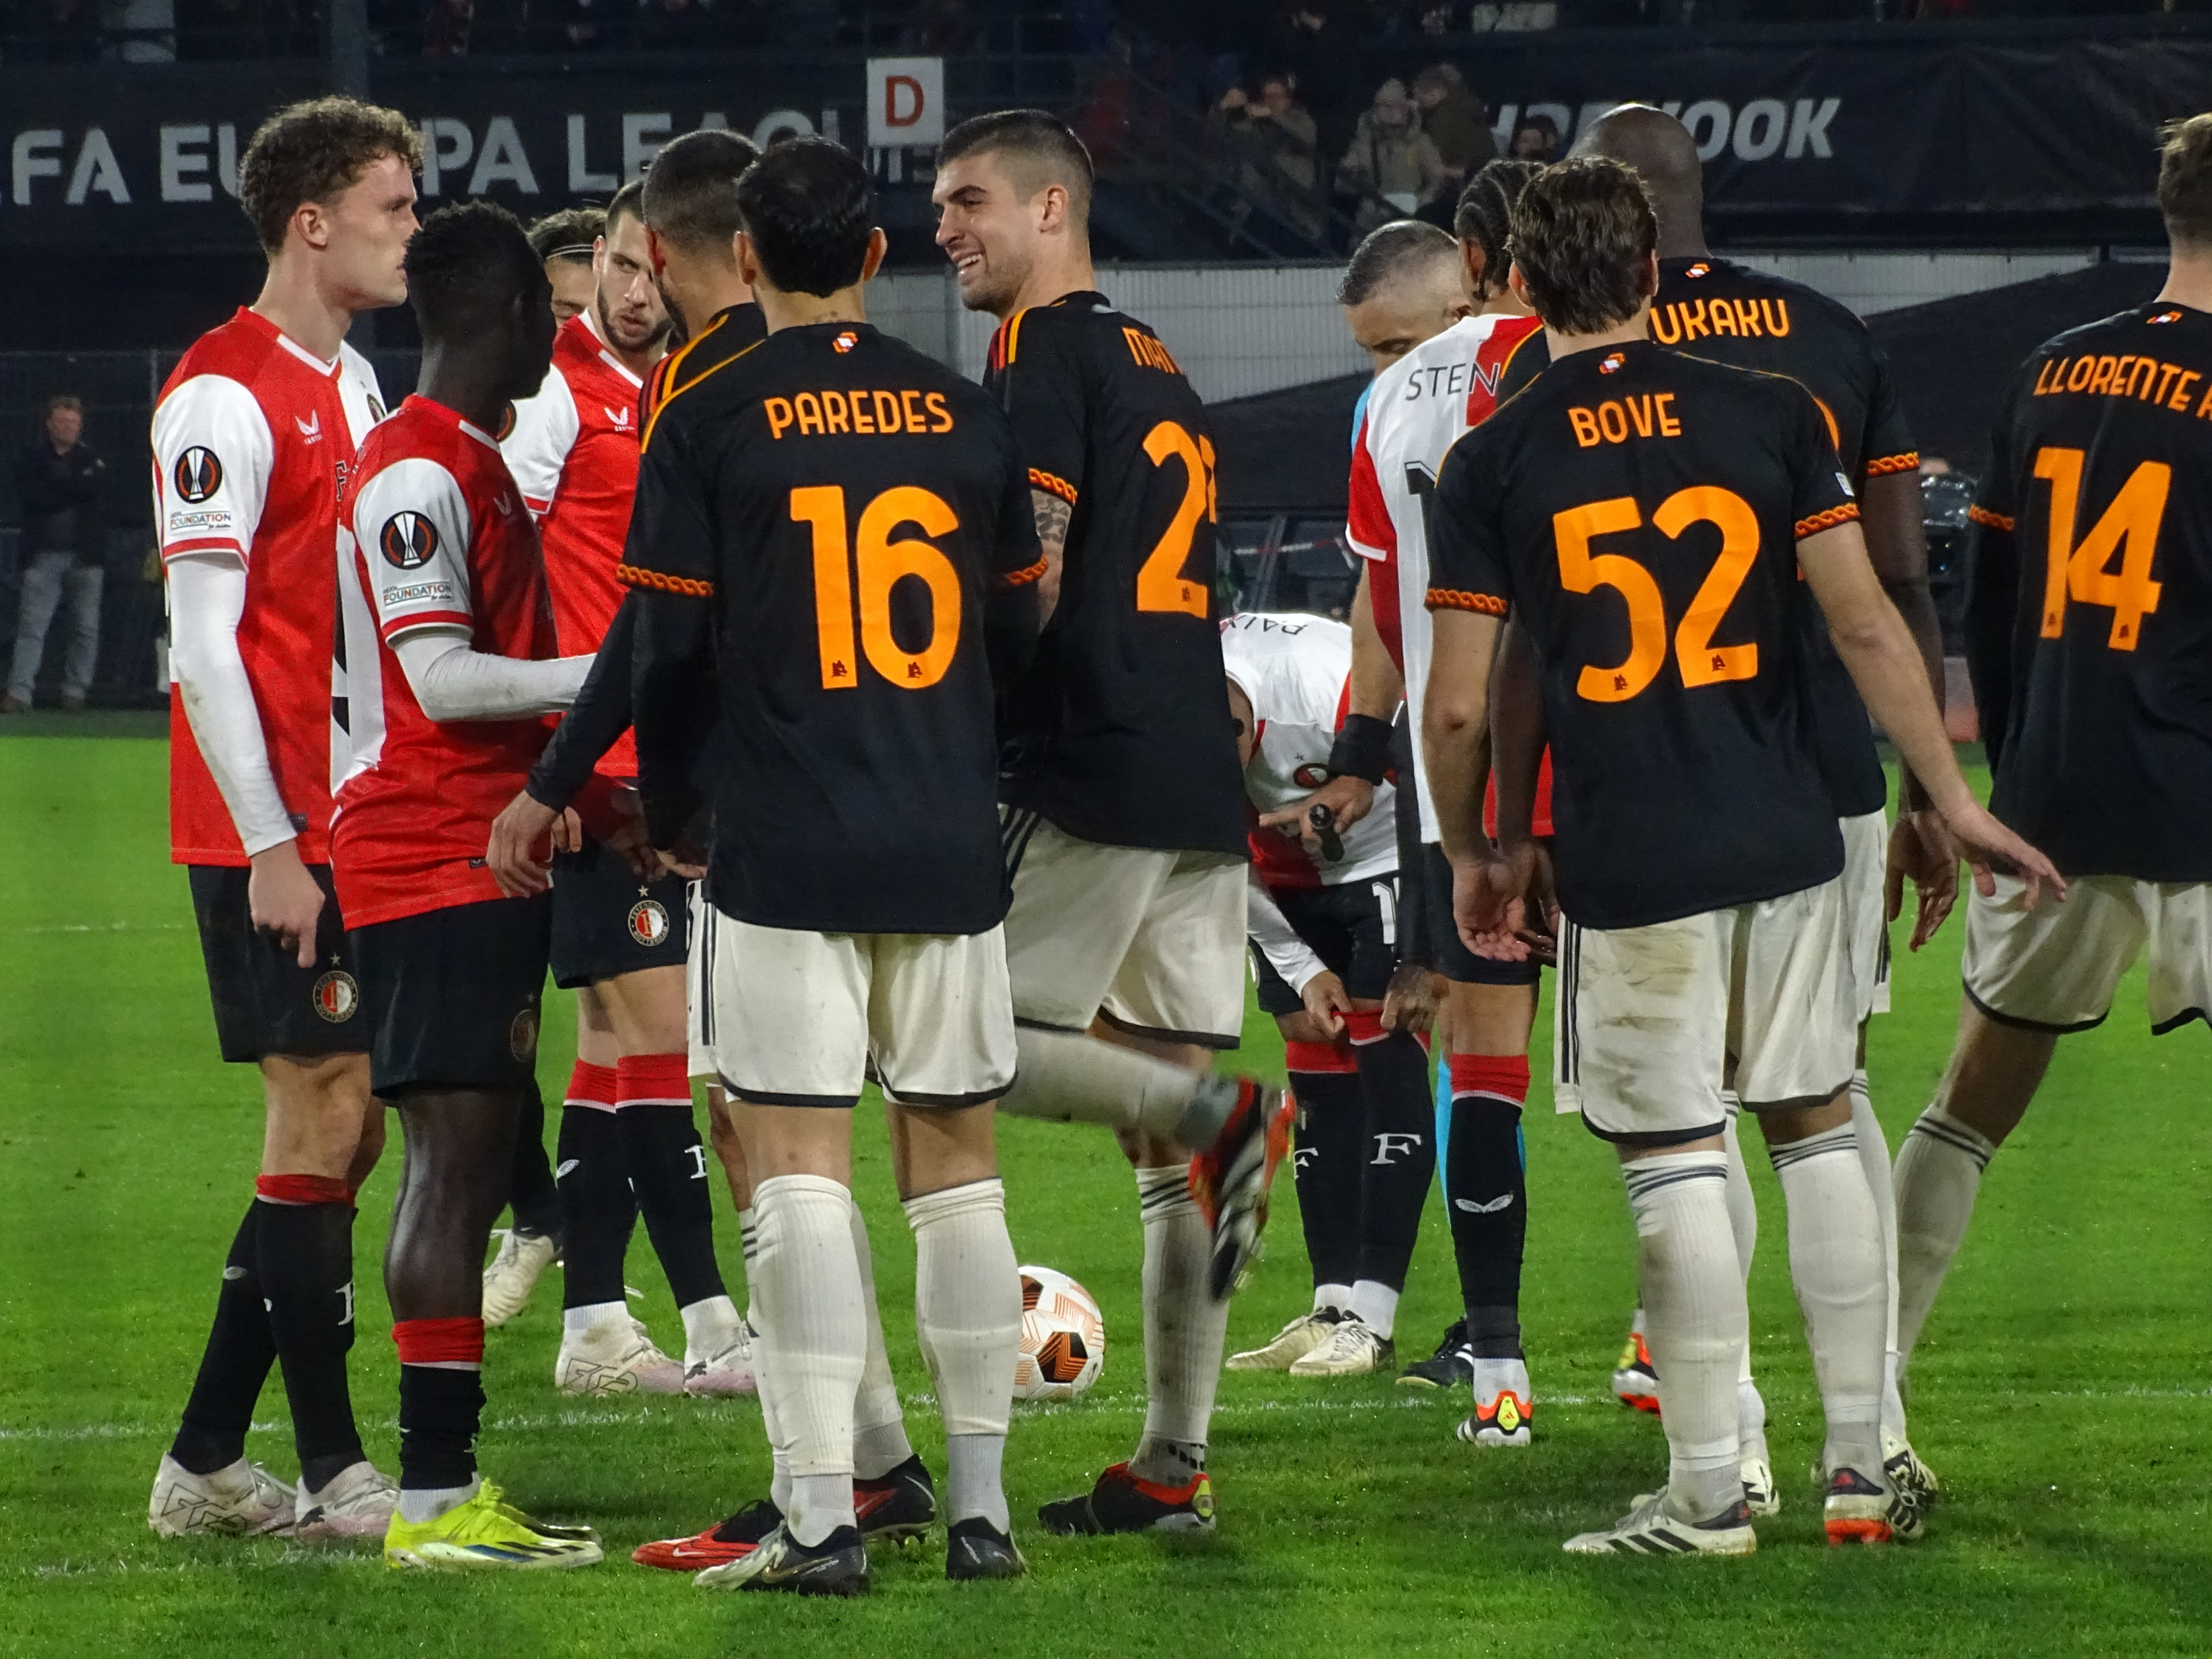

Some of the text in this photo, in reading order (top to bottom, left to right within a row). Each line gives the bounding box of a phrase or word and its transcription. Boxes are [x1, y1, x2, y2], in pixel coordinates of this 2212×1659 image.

[885, 75, 924, 127] D
[1406, 362, 1501, 401] STEN
[2033, 354, 2202, 412] LLORENTE
[764, 390, 954, 439] PAREDES
[1567, 393, 1682, 448] BOVE
[171, 513, 231, 528] FOUNDATION
[2033, 446, 2172, 652] 14
[383, 584, 450, 604] FOUNDATION
[790, 486, 963, 689] 16
[1552, 484, 1760, 703] 52
[1370, 1132, 1421, 1165] F
